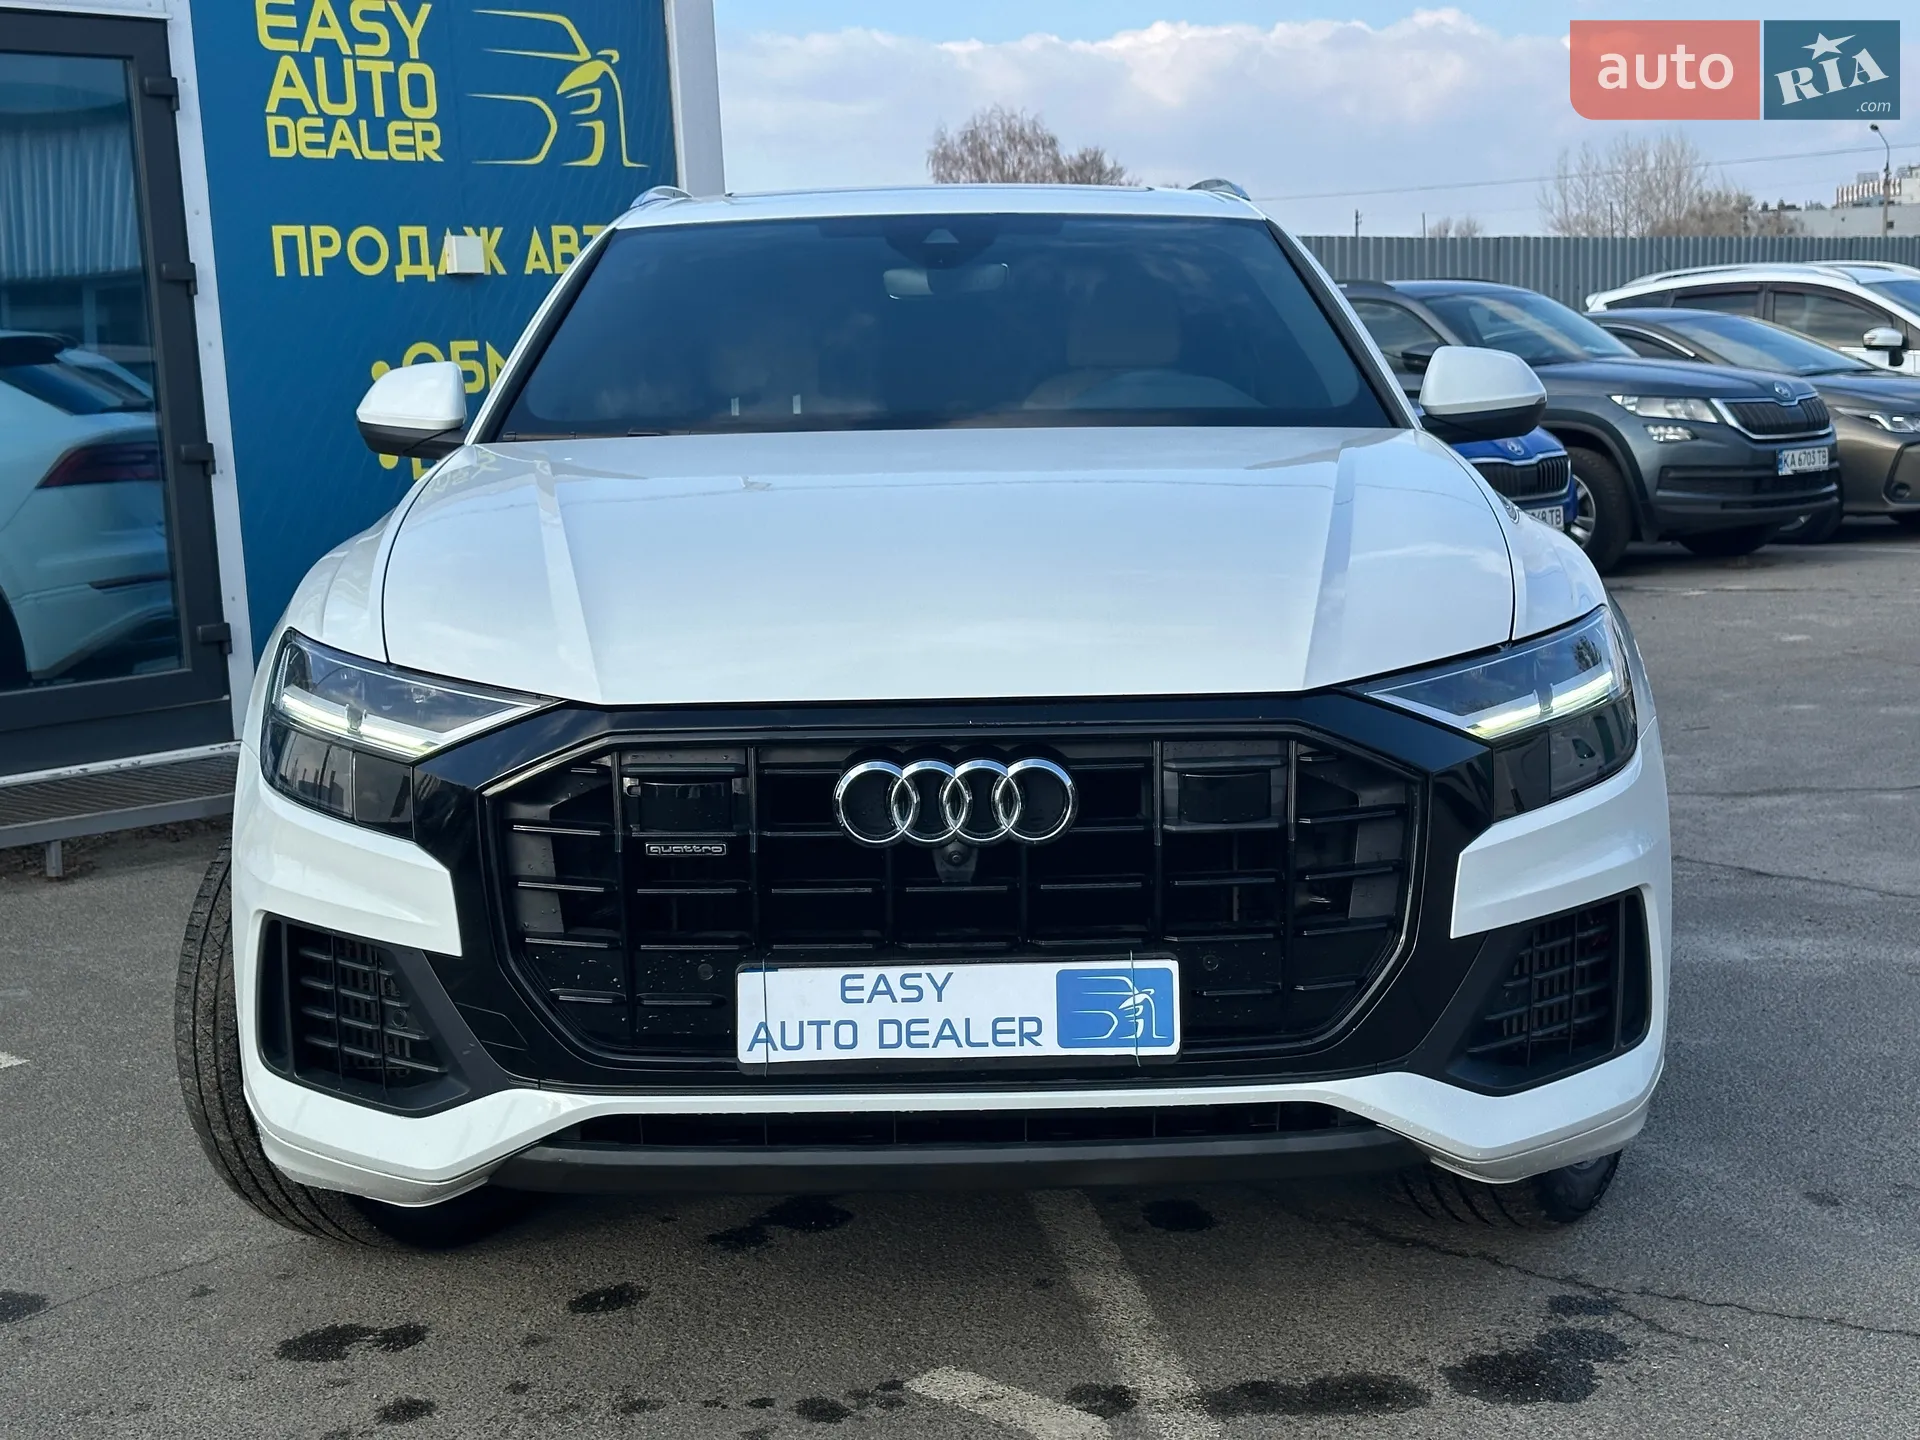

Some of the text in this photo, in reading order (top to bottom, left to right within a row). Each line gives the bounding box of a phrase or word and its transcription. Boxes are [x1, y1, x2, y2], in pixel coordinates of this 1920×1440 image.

[255, 0, 432, 59] EASY
[265, 55, 437, 119] AUTO
[266, 116, 444, 162] DEALER
[649, 845, 723, 855] quattro
[839, 971, 954, 1005] EASY
[746, 1015, 1043, 1052] AUTO DEALER
